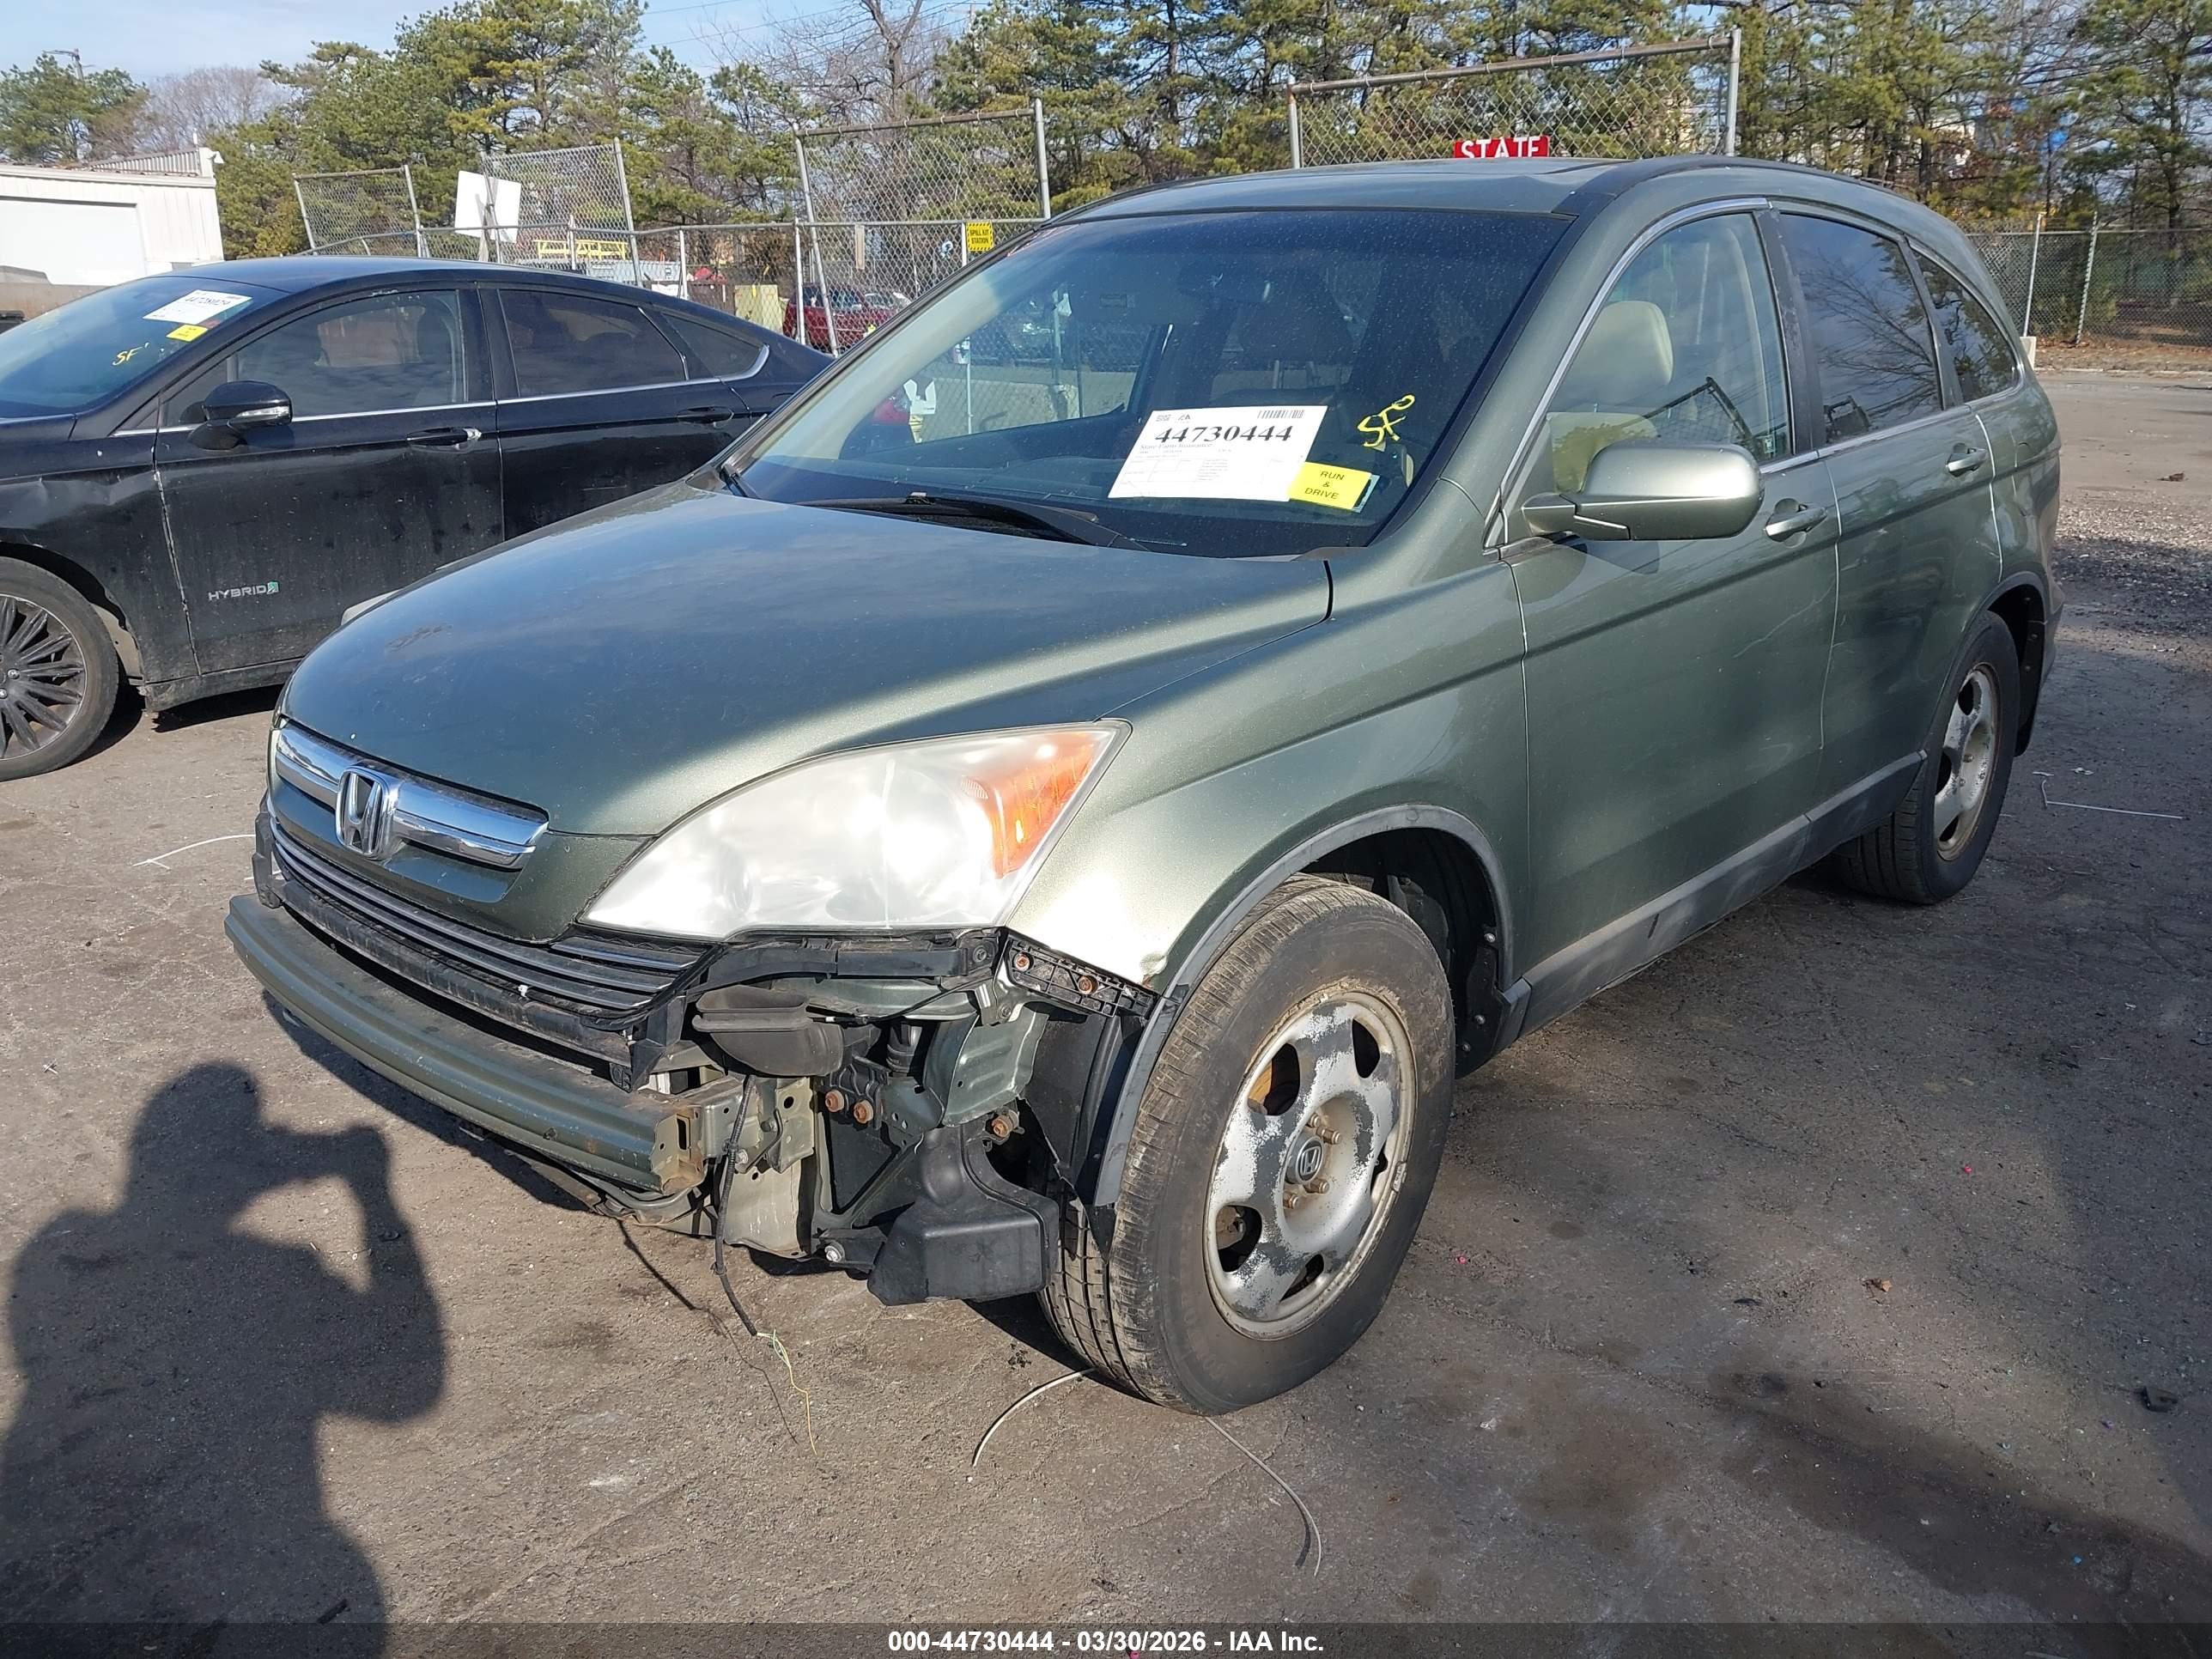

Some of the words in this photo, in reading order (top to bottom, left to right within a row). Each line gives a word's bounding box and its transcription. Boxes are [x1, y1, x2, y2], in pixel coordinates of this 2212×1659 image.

[1461, 136, 1540, 158] STATE
[1155, 425, 1294, 443] 44730444
[1320, 471, 1346, 481] RUN
[1304, 487, 1340, 500] DRIVE
[208, 585, 267, 601] HYBRID
